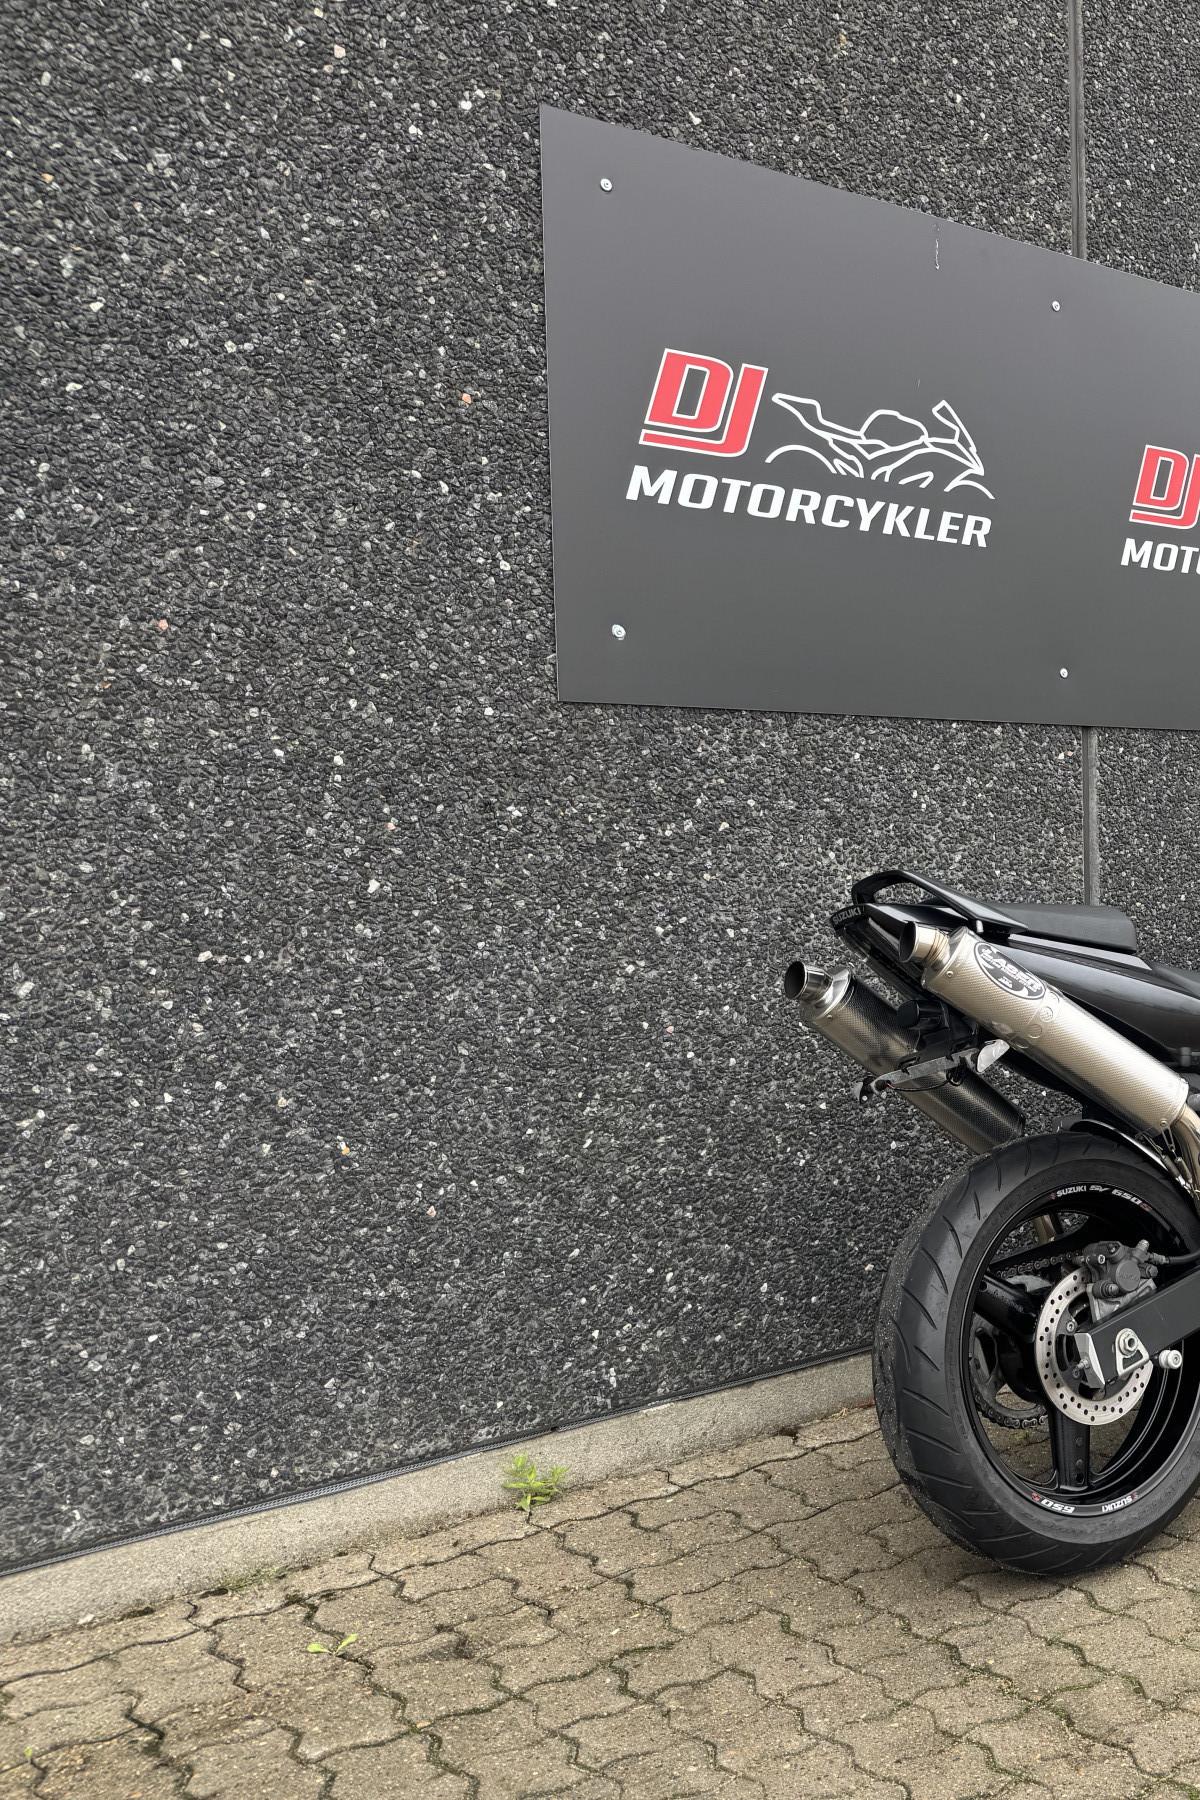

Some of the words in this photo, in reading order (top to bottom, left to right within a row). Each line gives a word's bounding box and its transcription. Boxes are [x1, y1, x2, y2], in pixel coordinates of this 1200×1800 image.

[639, 348, 769, 458] DJ
[625, 464, 993, 548] MOTORCYKLER
[832, 907, 861, 924] SUZUKI
[1056, 1185, 1087, 1197] SUZUKI
[1102, 1495, 1132, 1513] SUZUKI
